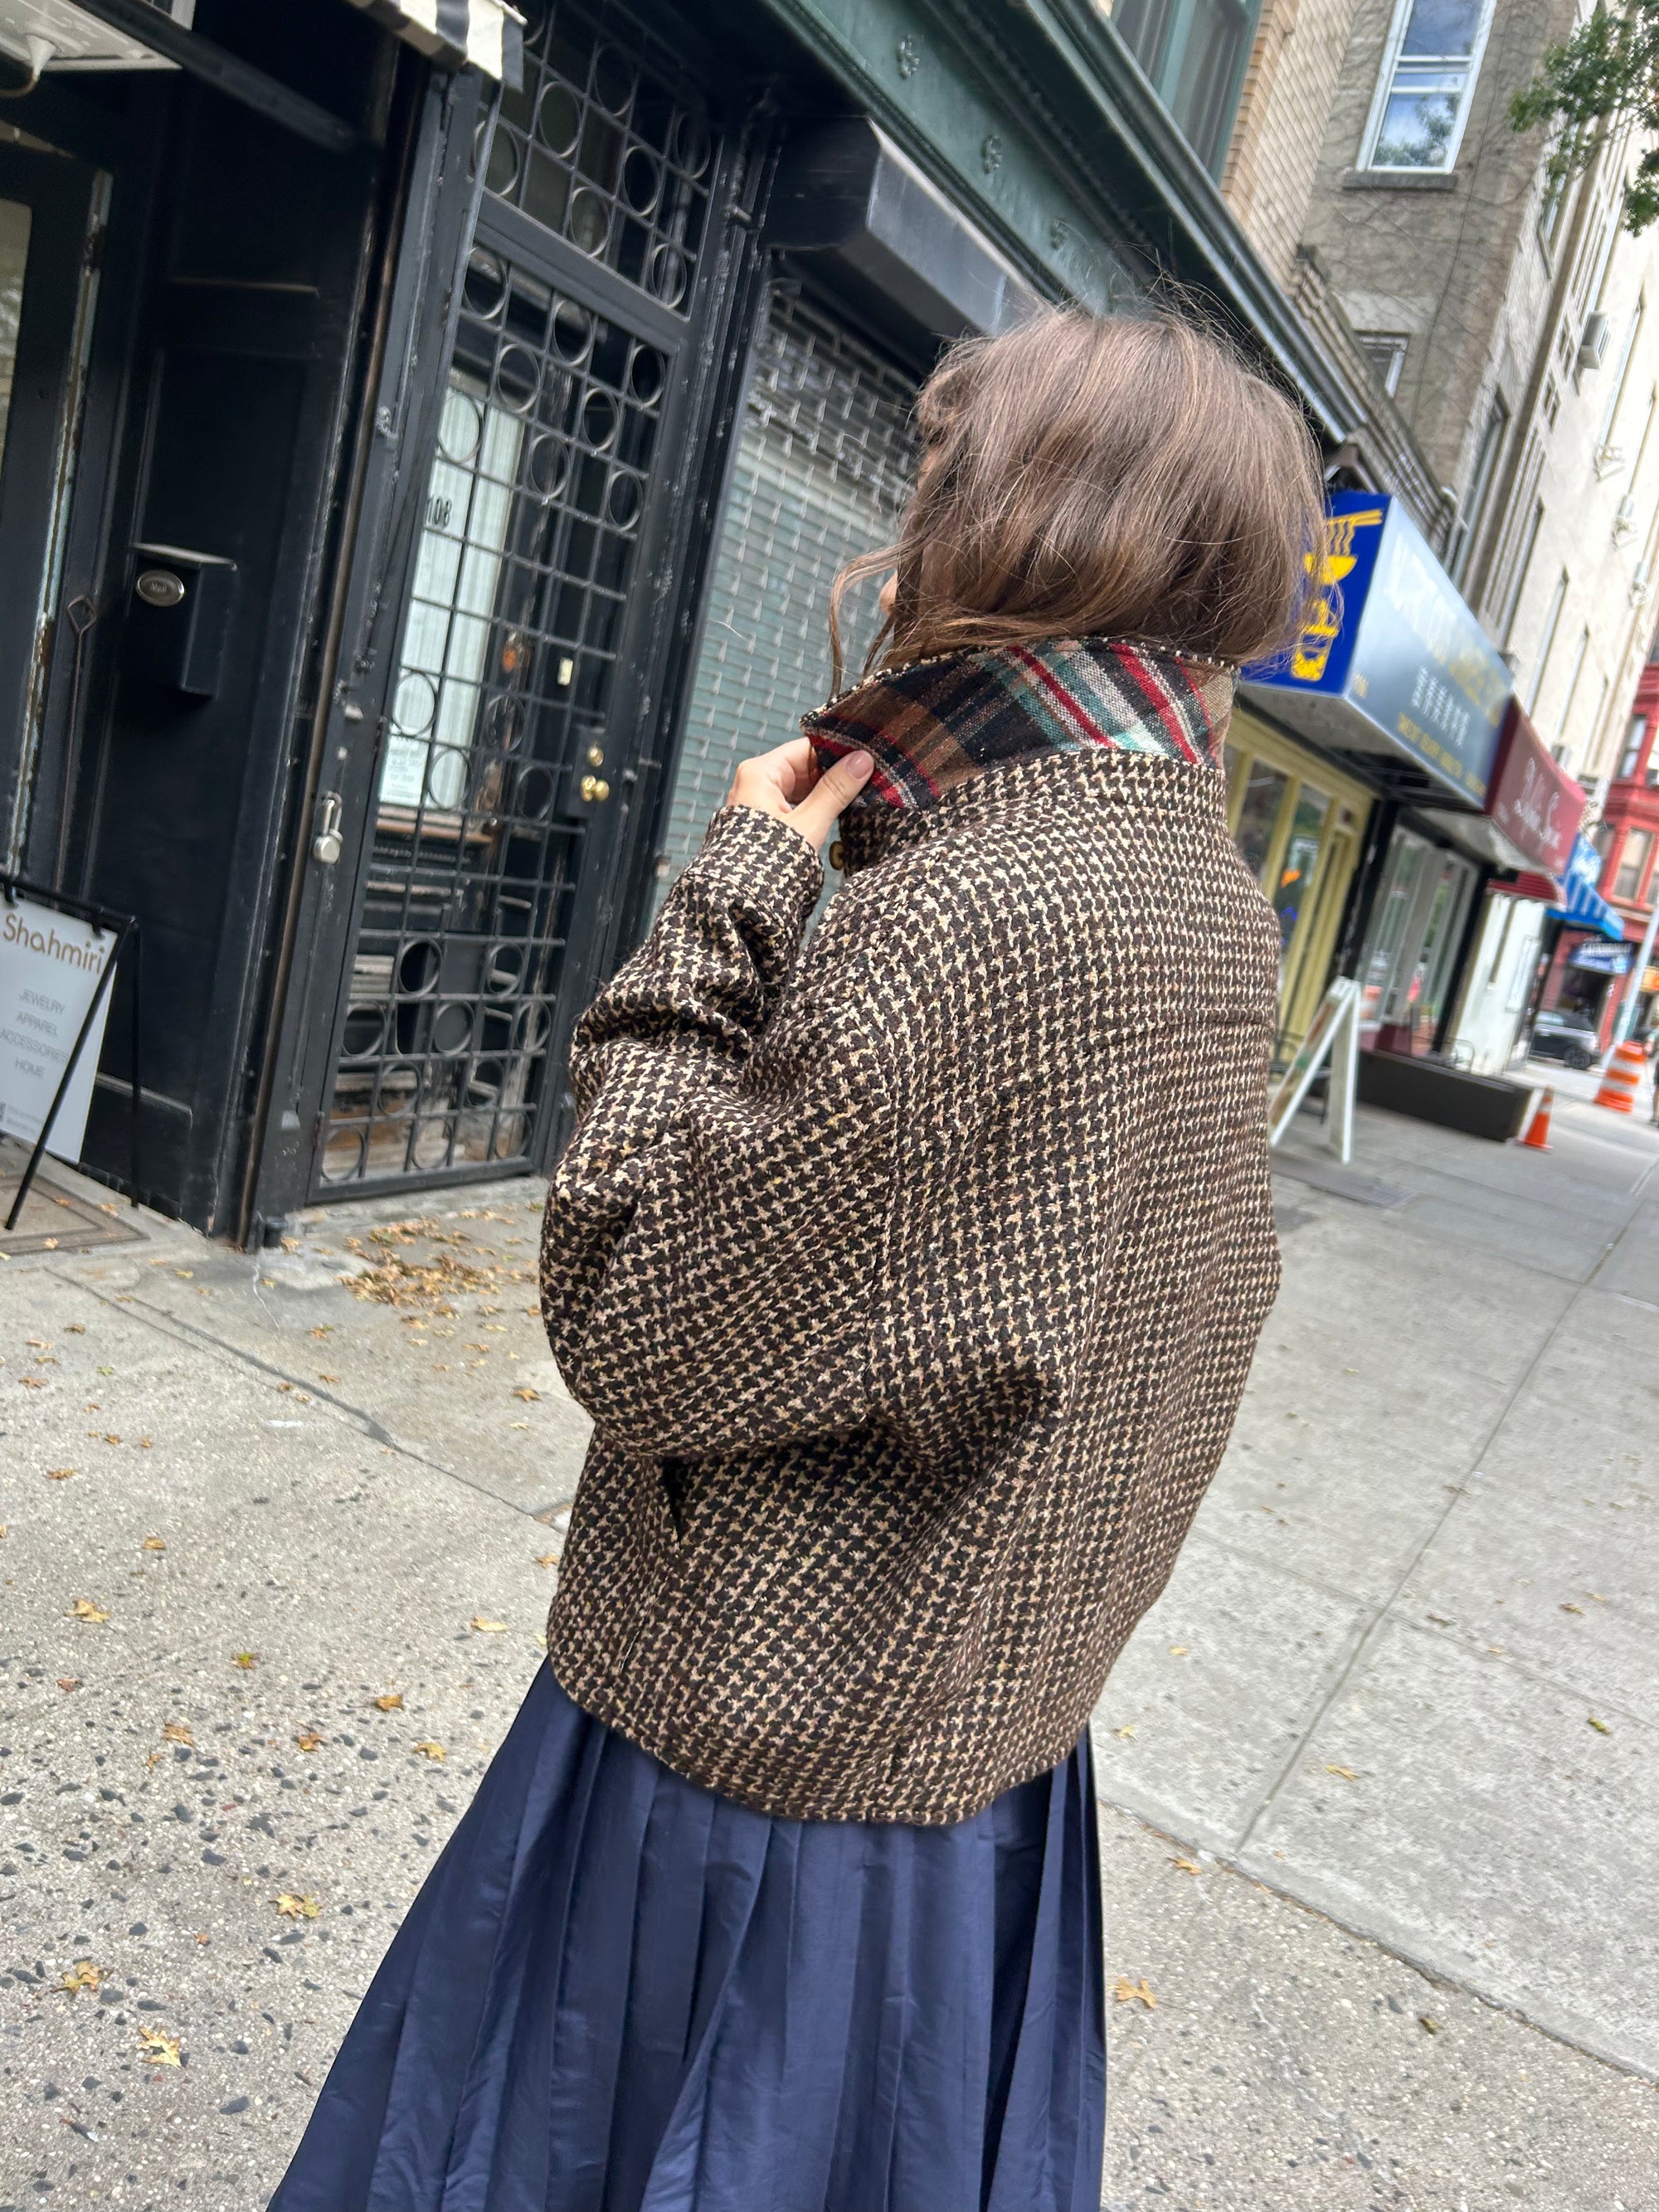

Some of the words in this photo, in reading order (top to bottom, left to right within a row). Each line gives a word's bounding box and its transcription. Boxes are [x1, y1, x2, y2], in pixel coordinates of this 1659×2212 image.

[426, 495, 452, 527] 108
[3, 912, 105, 974] Shahmiri
[19, 988, 66, 1014] JEWELRY
[16, 1011, 59, 1038] APPAREL
[14, 1057, 46, 1078] HOME
